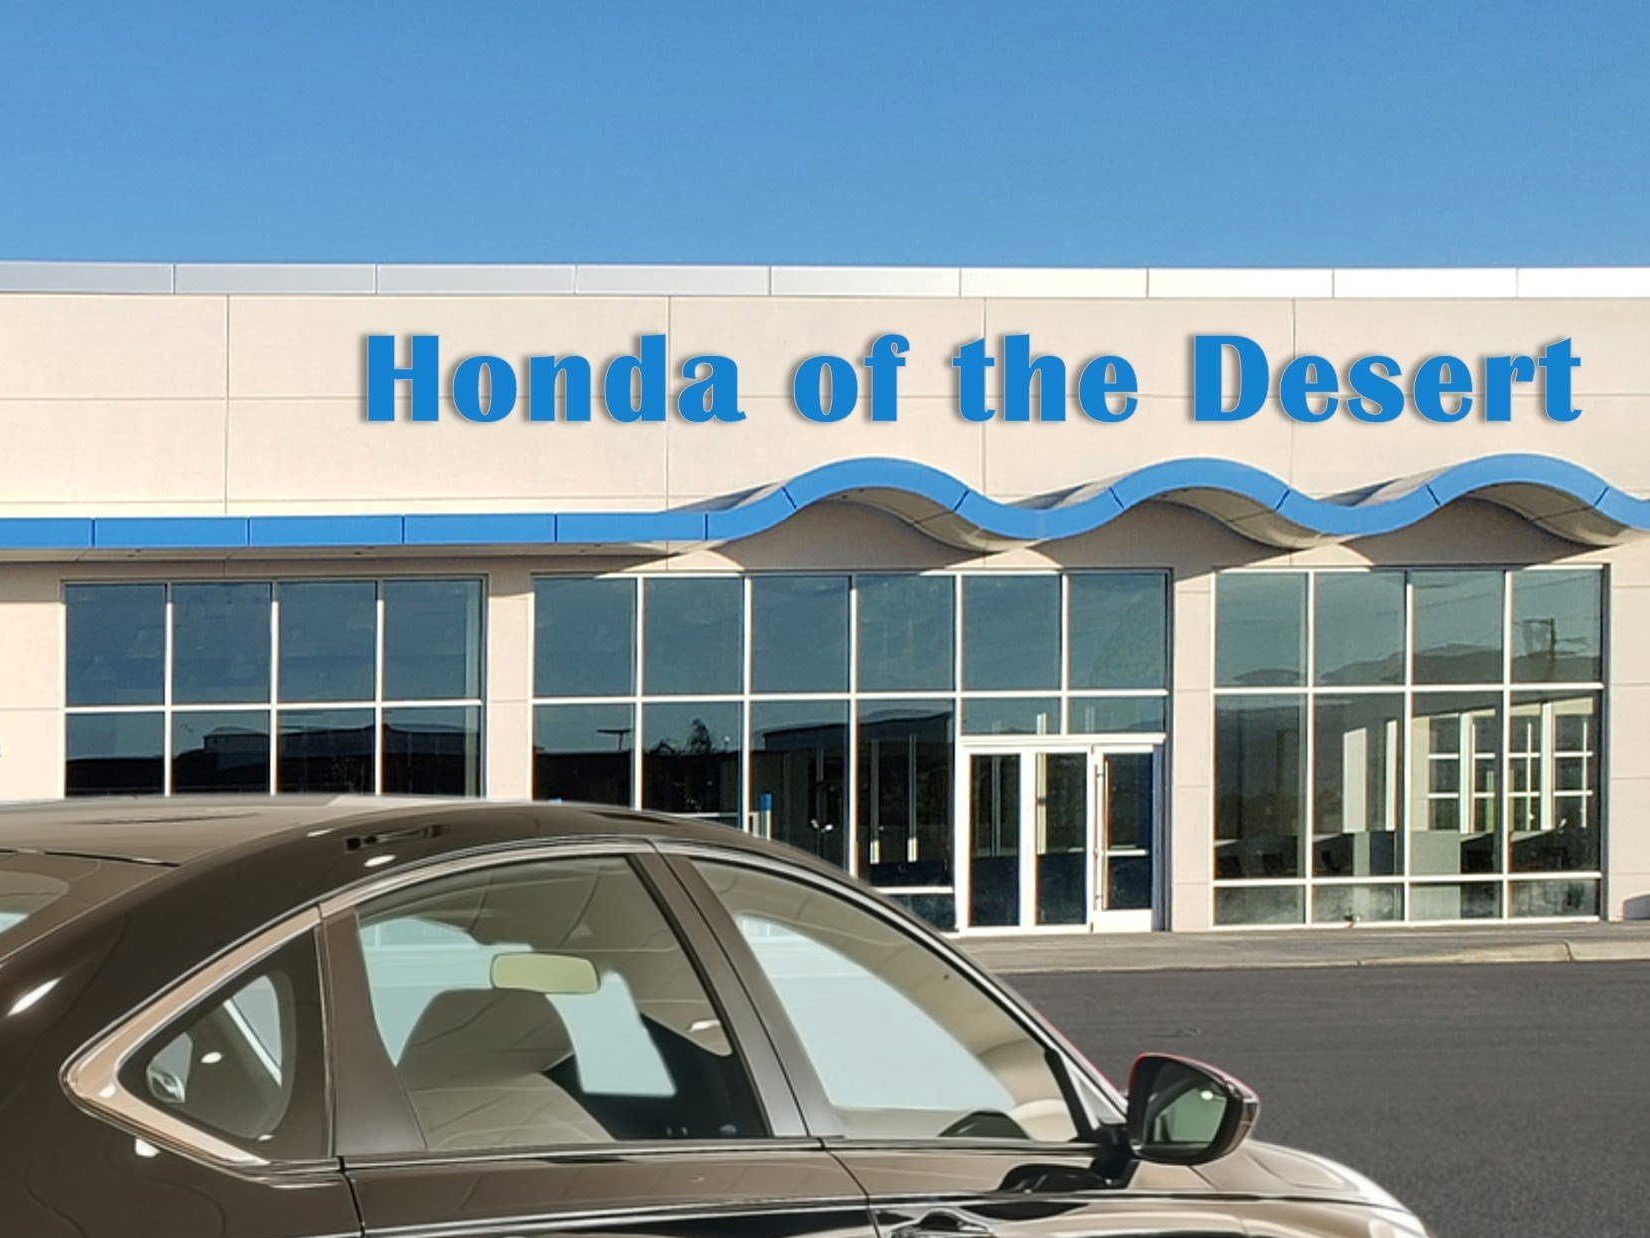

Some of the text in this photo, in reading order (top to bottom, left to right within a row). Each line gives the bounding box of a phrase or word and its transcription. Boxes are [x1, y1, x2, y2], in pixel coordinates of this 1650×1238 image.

[366, 333, 1583, 423] Honda of the Desert
